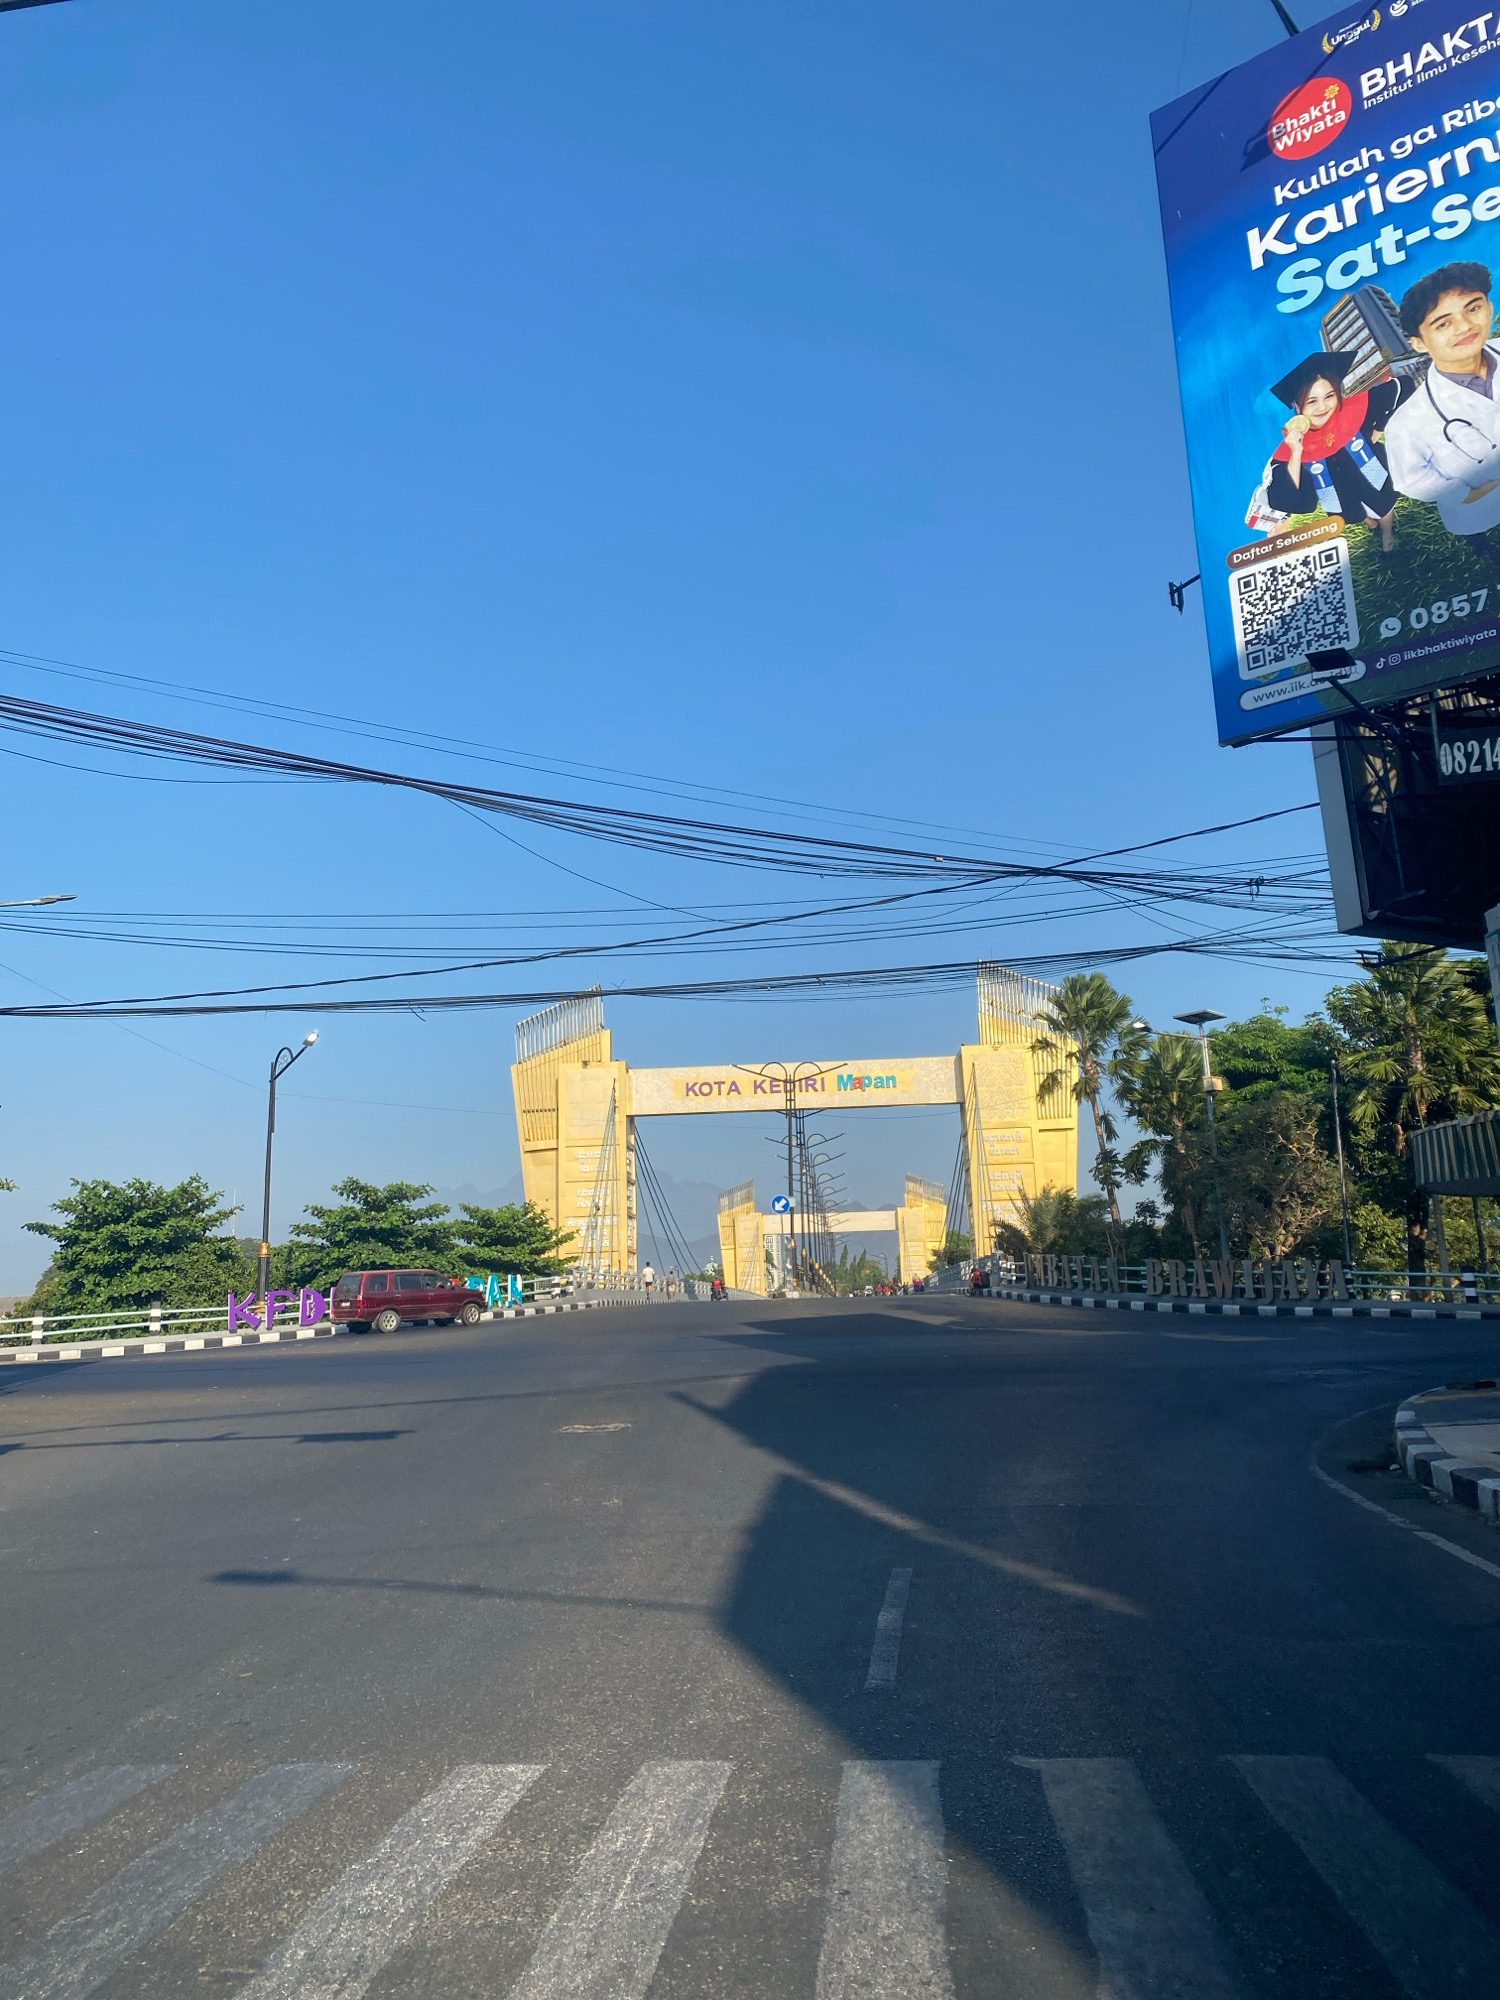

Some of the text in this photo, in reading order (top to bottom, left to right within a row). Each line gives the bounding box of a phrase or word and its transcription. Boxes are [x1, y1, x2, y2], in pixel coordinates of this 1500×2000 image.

[1331, 19, 1371, 45] Unggul
[1360, 11, 1500, 98] BHAKT
[1363, 76, 1414, 109] Institut
[1416, 63, 1448, 85] Ilmu
[1272, 98, 1337, 139] Bhakti
[1275, 110, 1346, 151] Wiyata
[1274, 147, 1384, 206] Kuliah
[1389, 124, 1437, 158] ga
[1247, 129, 1500, 271] Kariern
[1232, 521, 1338, 564] Daftar Sekarang
[1410, 588, 1489, 629] 0857
[1404, 627, 1497, 661] iikbhaktiwiyata
[685, 1080, 742, 1097] KOTA
[837, 1073, 898, 1092] Mapan
[1145, 1258, 1352, 1304] BRAWIJAYA
